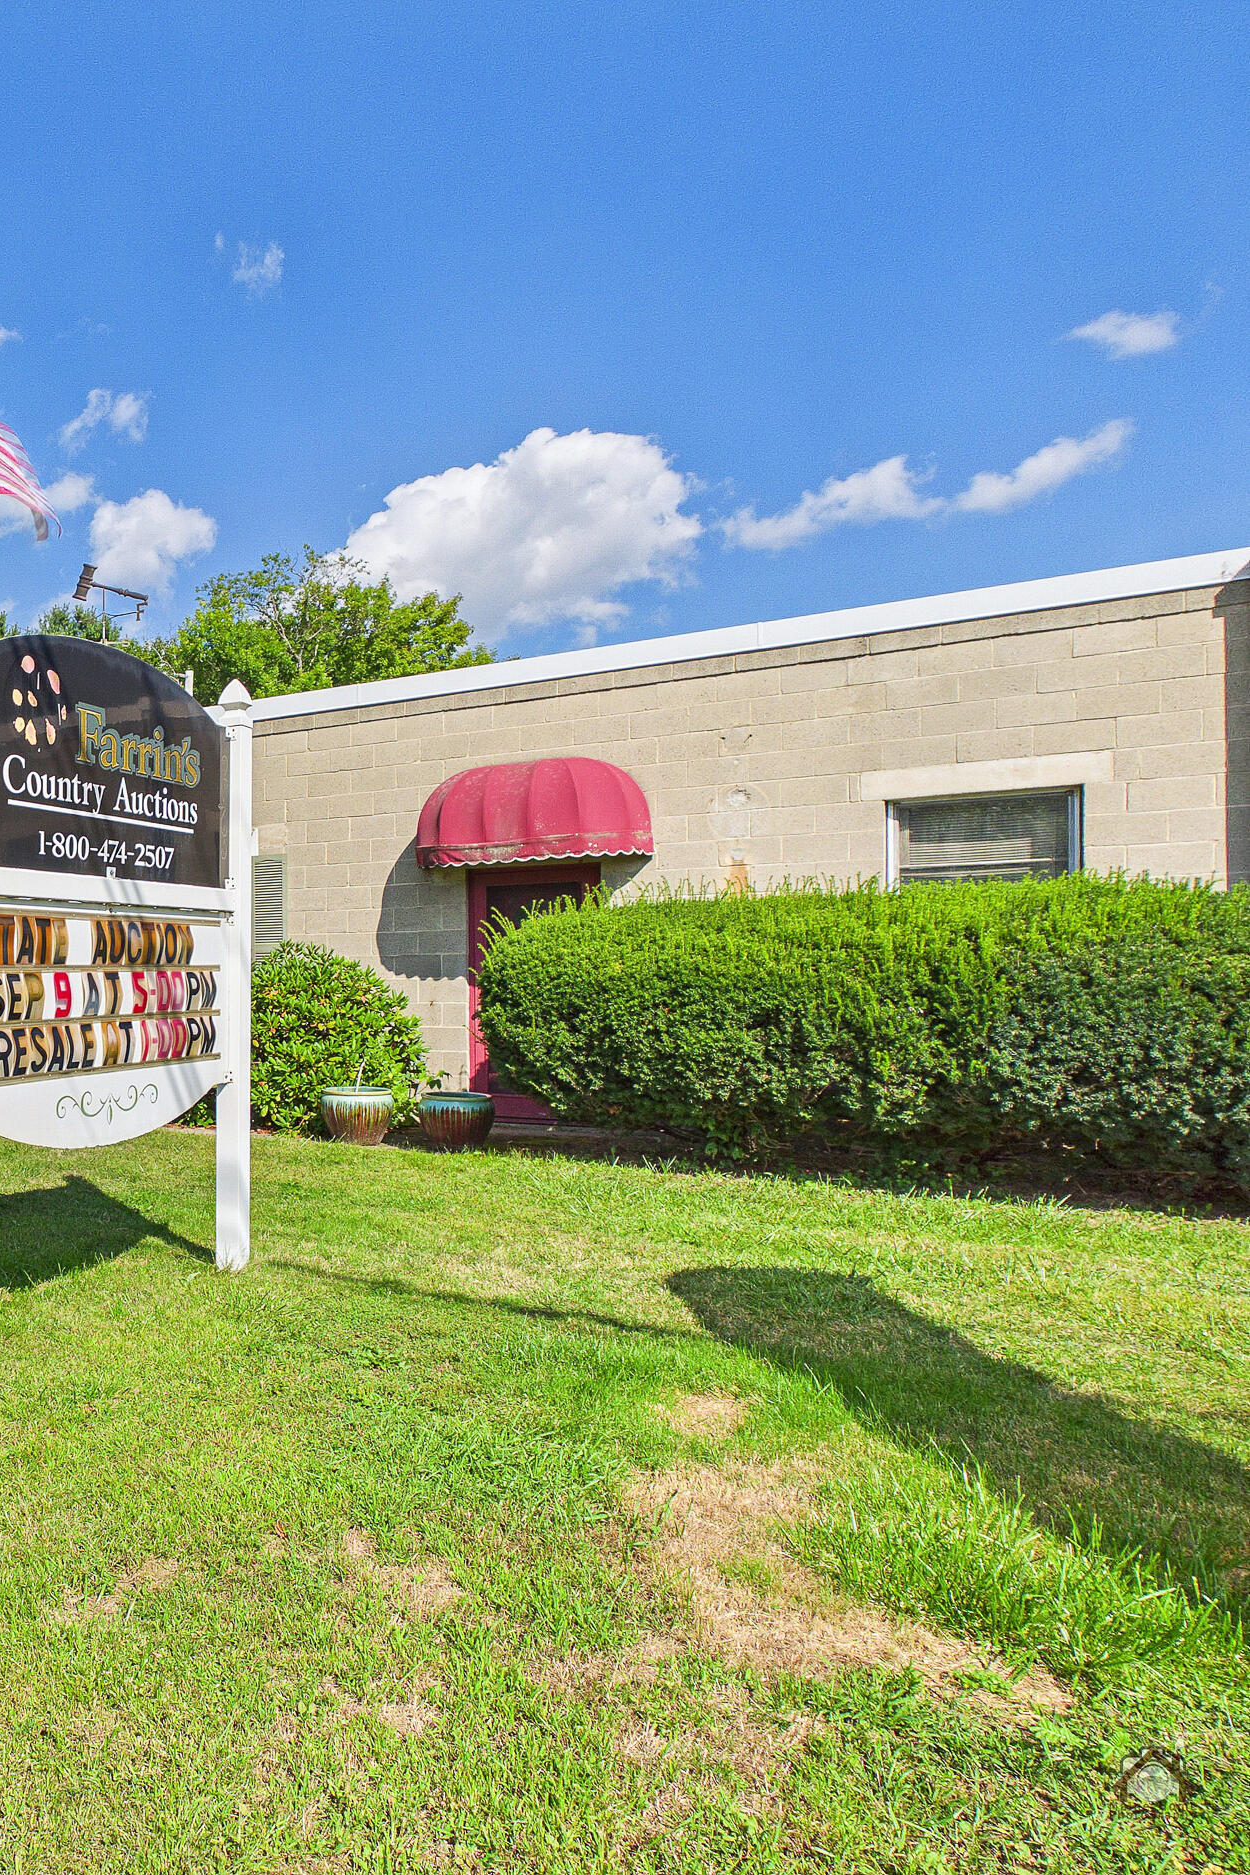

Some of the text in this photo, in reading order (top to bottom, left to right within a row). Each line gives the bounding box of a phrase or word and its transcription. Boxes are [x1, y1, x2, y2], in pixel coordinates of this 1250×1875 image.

[75, 701, 201, 789] Farrin's
[2, 754, 198, 826] Country Auctions
[38, 830, 174, 870] 1-800-474-2507
[92, 919, 194, 965] AUCTION
[54, 971, 72, 1018] 9
[84, 972, 121, 1016] AT
[102, 1020, 134, 1066] AT
